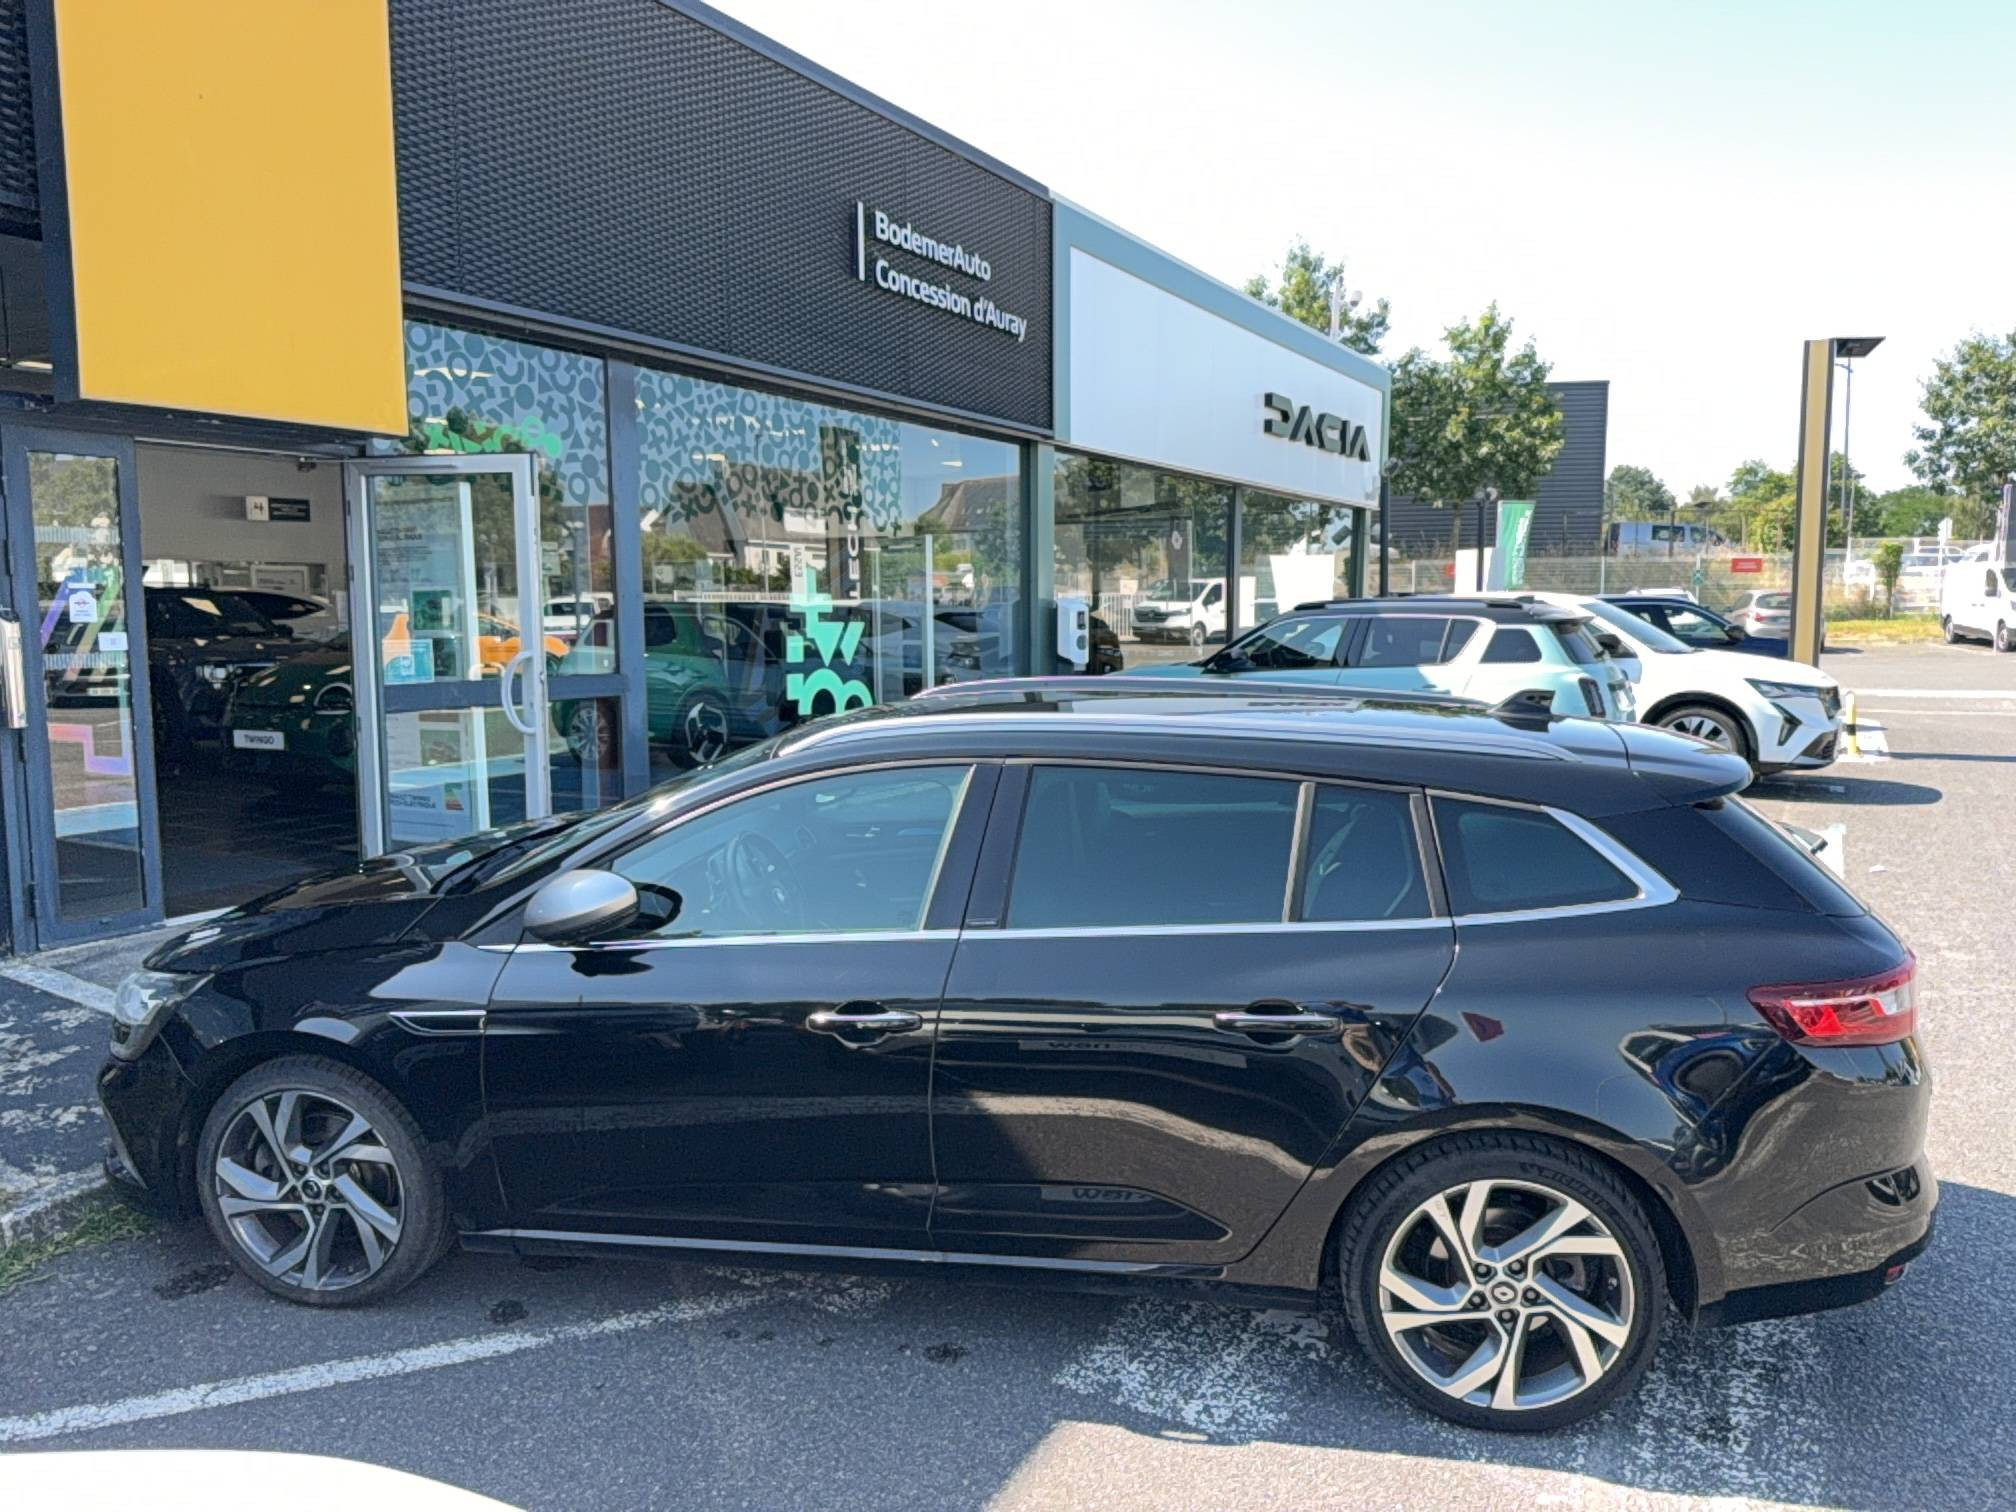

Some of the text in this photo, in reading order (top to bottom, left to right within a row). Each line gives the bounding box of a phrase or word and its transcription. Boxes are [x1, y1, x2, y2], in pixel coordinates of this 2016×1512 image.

[875, 210, 991, 281] BodemerAuto
[875, 258, 1027, 342] Concession d'Auray
[1264, 392, 1370, 462] DACIA
